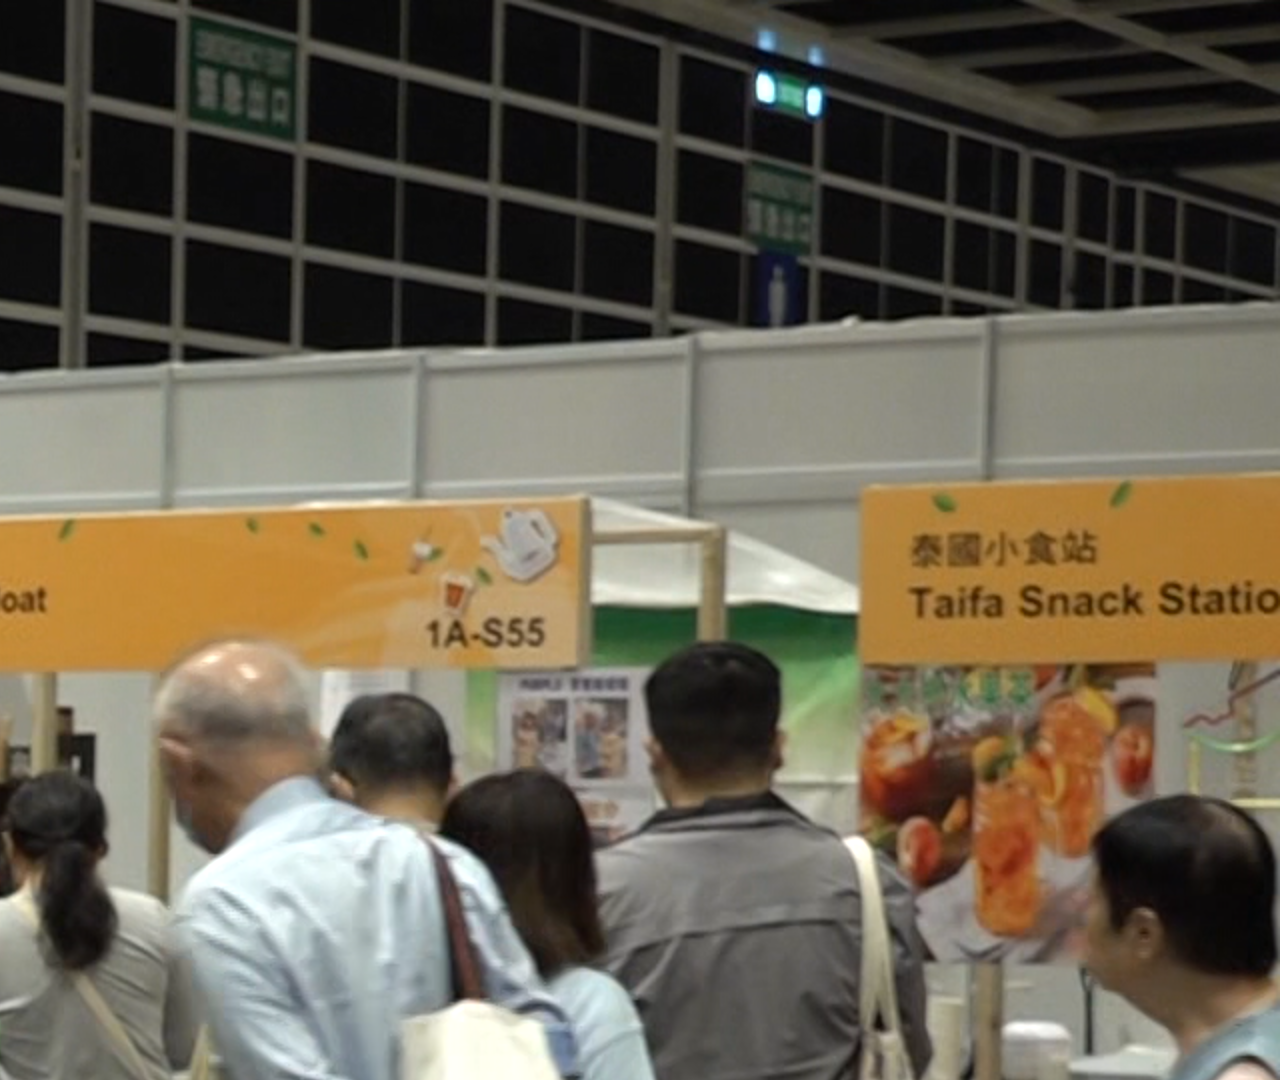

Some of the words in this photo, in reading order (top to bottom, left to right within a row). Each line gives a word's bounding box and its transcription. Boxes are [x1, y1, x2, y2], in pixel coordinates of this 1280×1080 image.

[910, 529, 1098, 568] 泰國小食站
[908, 586, 1004, 620] Taifa
[1019, 583, 1144, 618] Snack
[425, 617, 546, 650] 1A-S55
